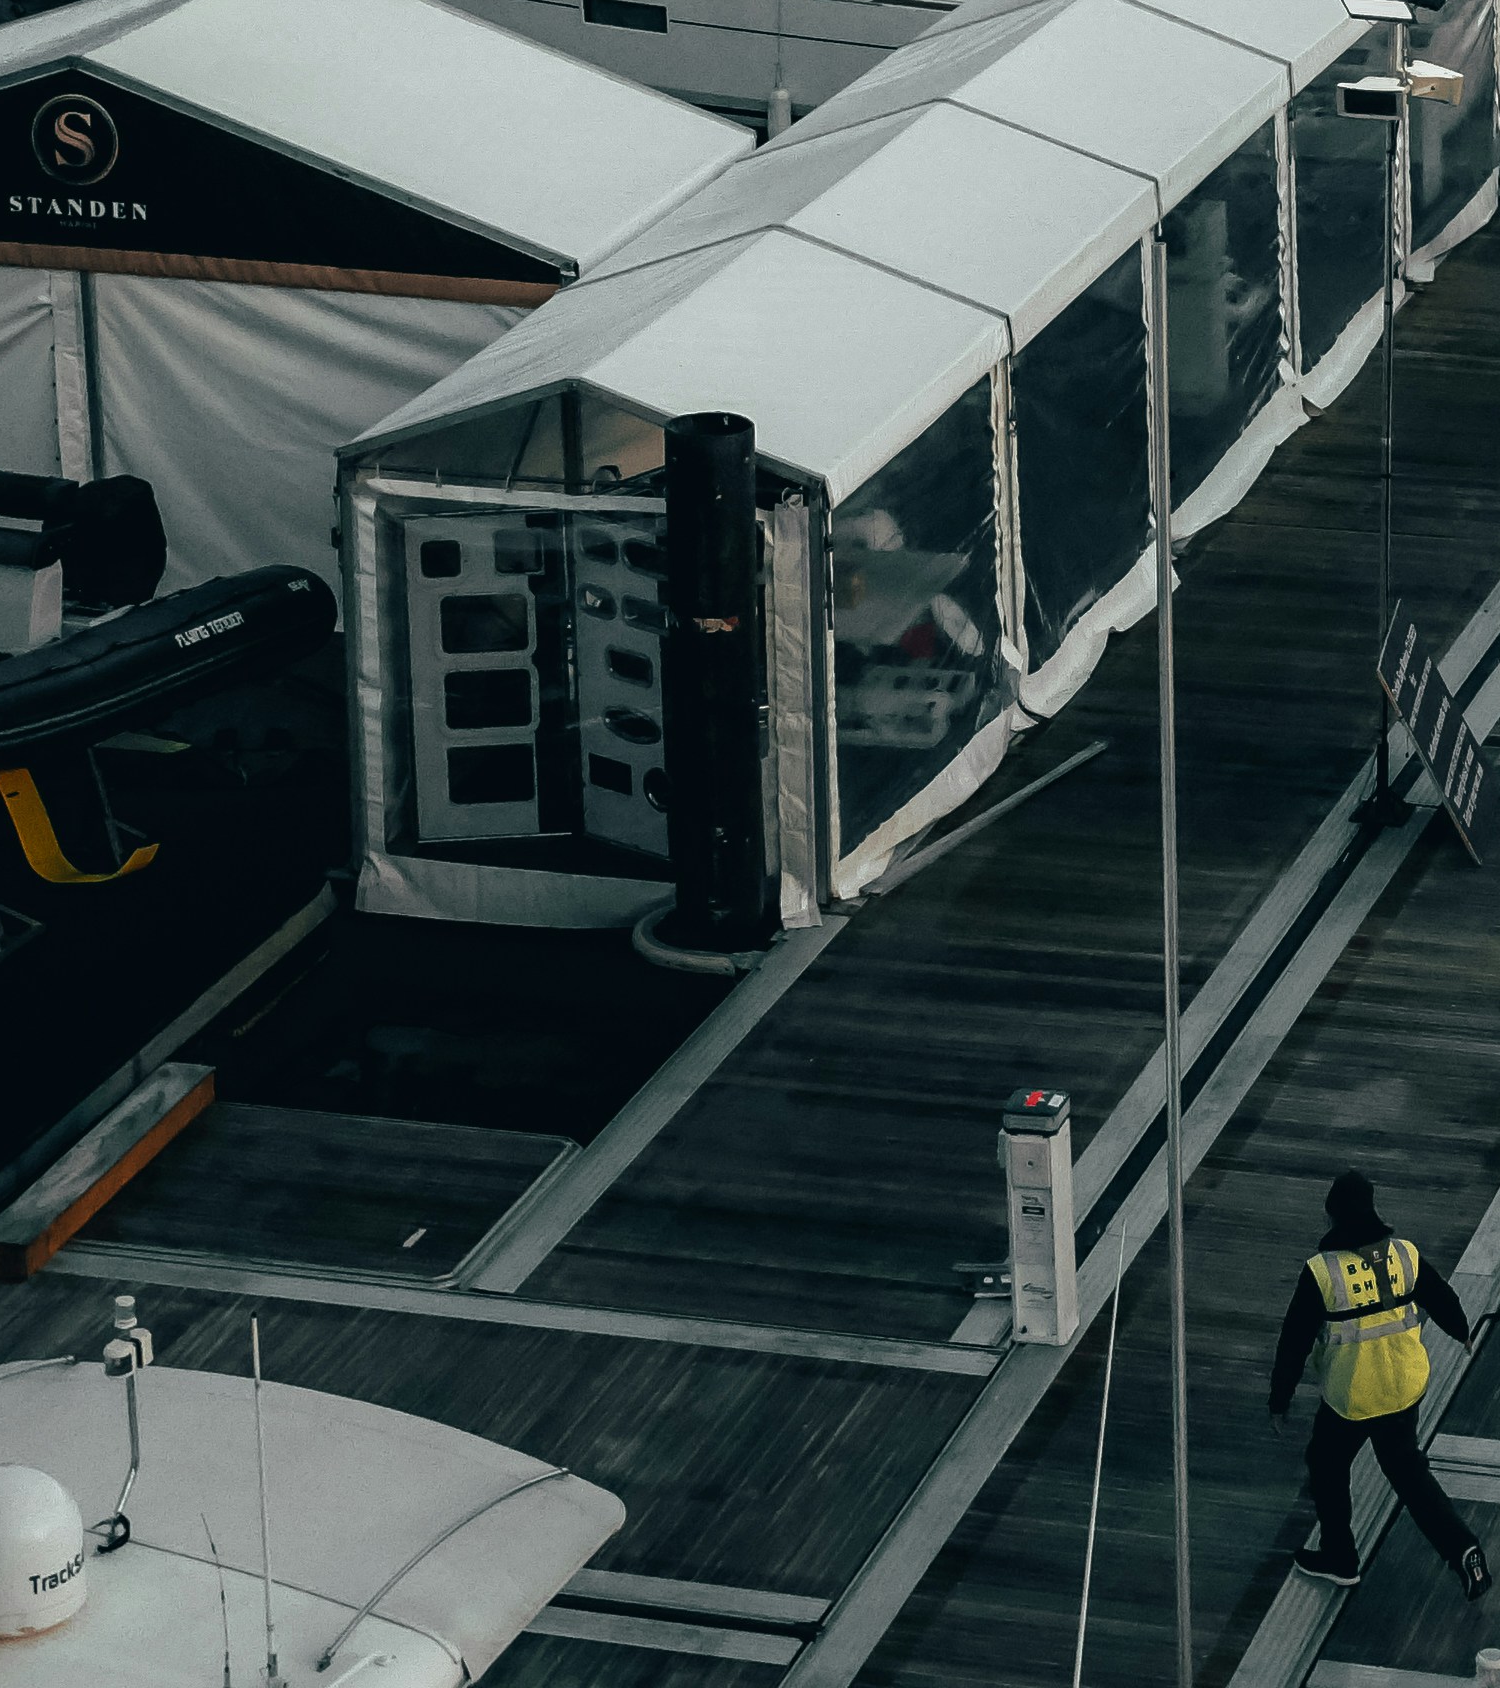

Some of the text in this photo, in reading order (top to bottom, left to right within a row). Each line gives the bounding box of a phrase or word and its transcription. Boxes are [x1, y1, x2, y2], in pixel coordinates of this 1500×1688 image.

[8, 195, 148, 221] STANDEN
[1346, 1253, 1395, 1276] BOT
[1351, 1272, 1399, 1296] SHW
[28, 1552, 86, 1595] TrackS
